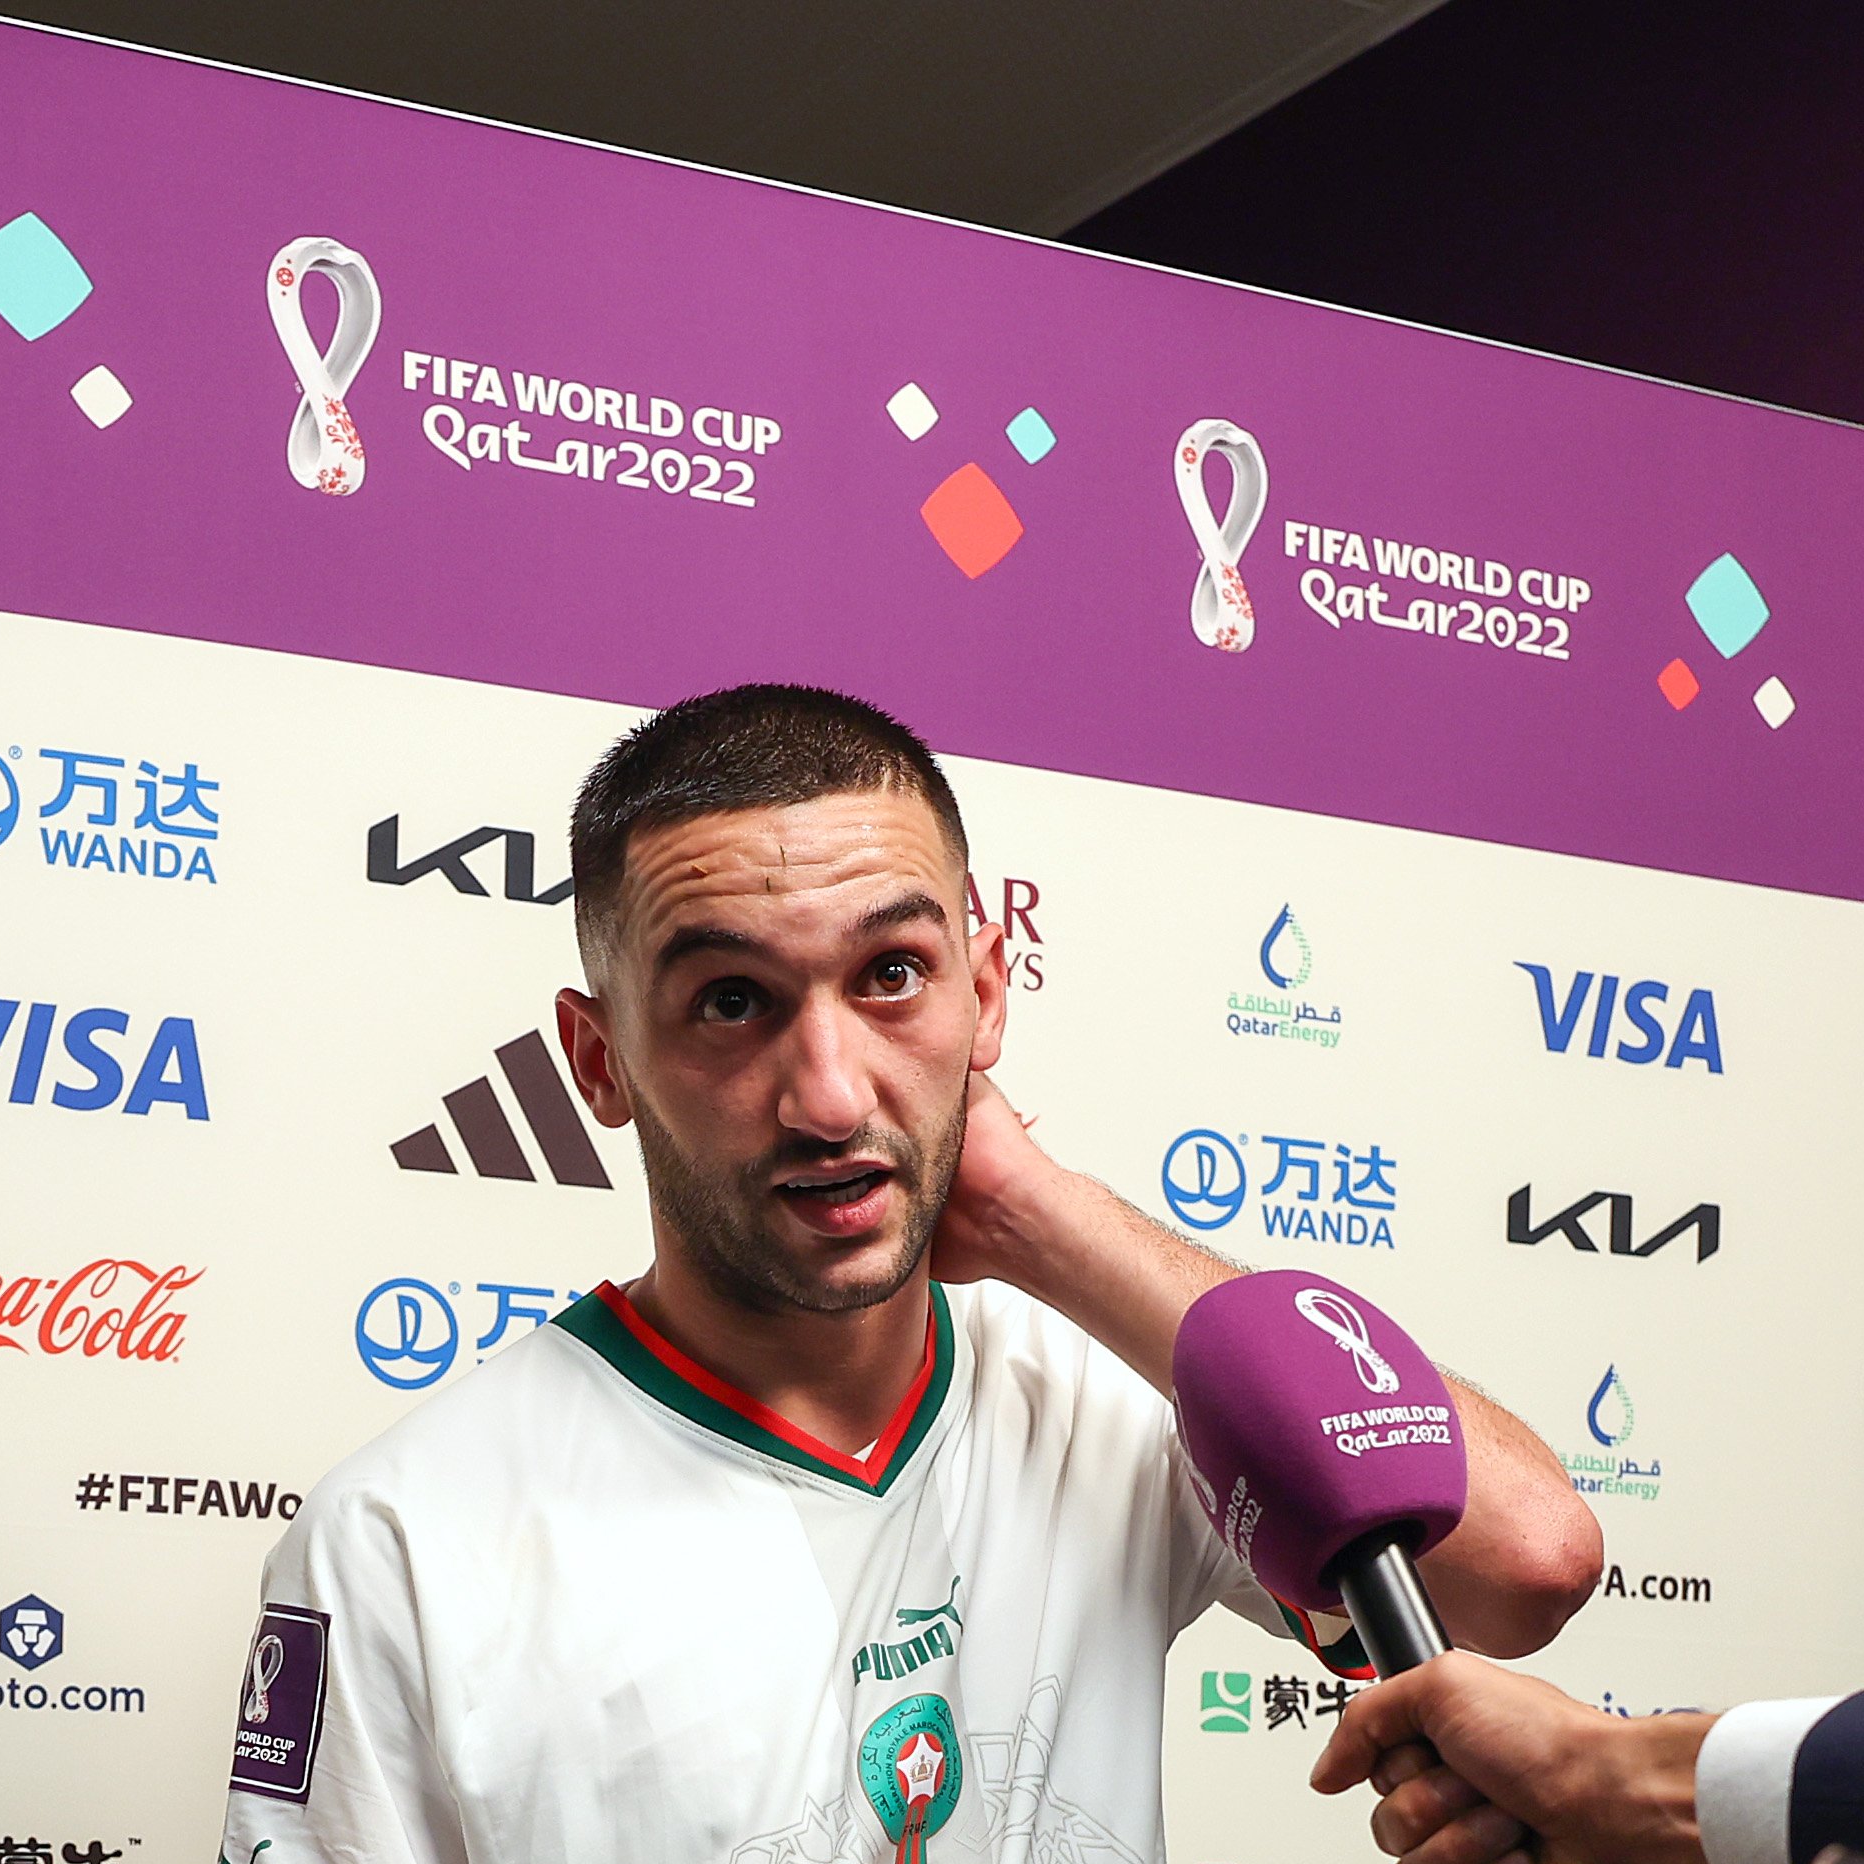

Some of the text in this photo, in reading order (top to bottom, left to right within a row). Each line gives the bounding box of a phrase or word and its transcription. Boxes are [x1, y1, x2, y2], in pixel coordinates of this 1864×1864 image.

[402, 350, 782, 455] FIFA WORLD CUP
[1284, 519, 1592, 613] FIFA WORLD CUP
[39, 748, 220, 841] 万达
[39, 827, 219, 885] WANDA
[1227, 1013, 1341, 1048] QatarEnergy
[1513, 961, 1724, 1075] VISA
[1261, 1135, 1397, 1211] 万达
[1262, 1204, 1395, 1250] WANDA
[1506, 1182, 1721, 1265] KIA
[477, 1283, 583, 1350] 万
[1320, 1406, 1450, 1435] FIFA WORLD CUP
[75, 1472, 304, 1521] #FIFAWo
[1572, 1475, 1660, 1500] atarEnergy
[1601, 1564, 1712, 1602] A.com
[852, 1621, 954, 1686] PUMA
[273, 1738, 295, 1751] CUP
